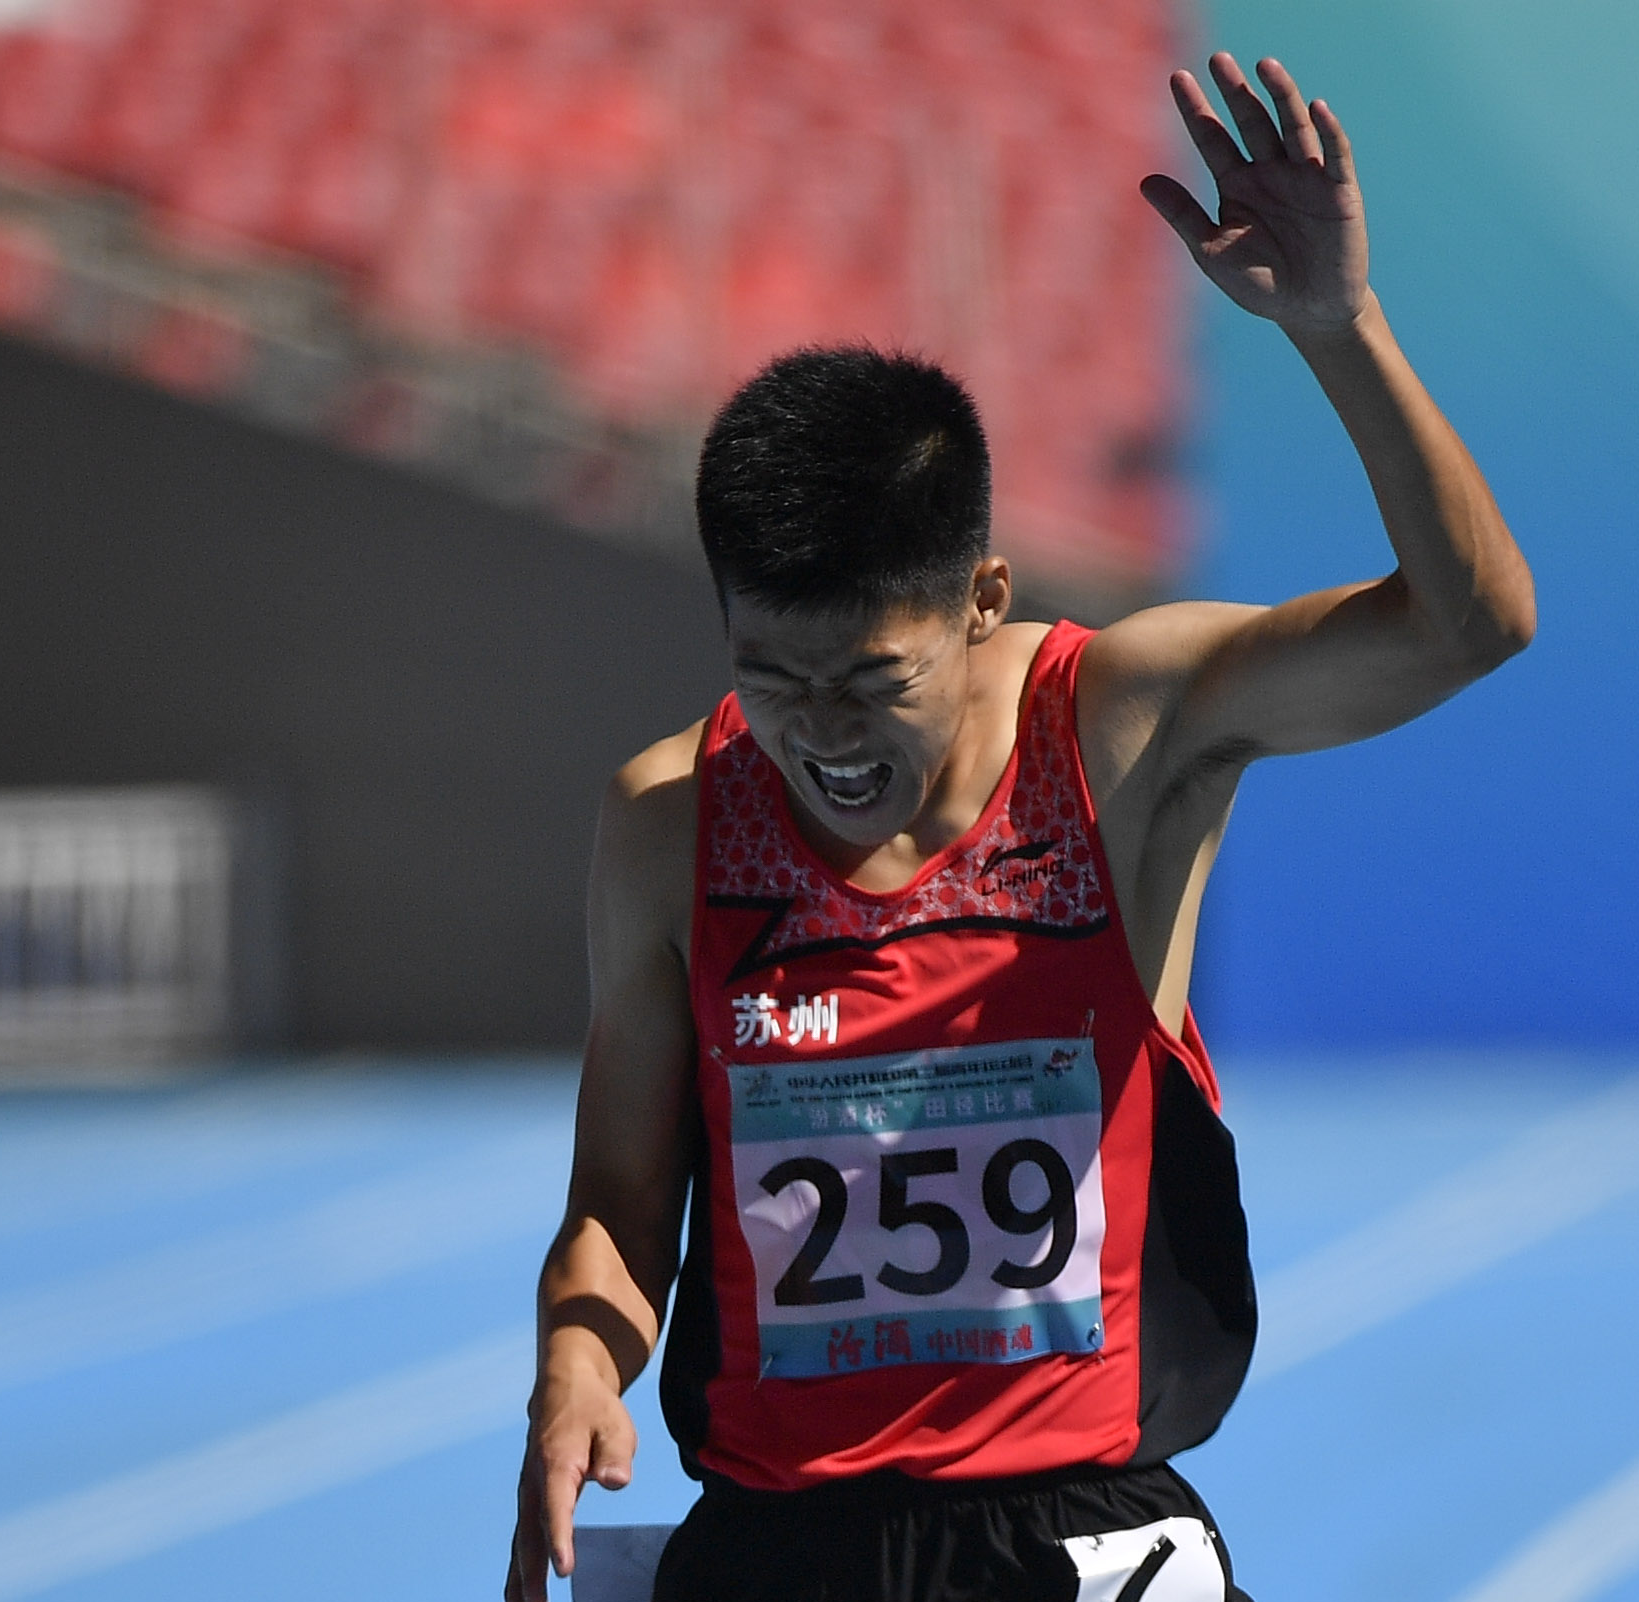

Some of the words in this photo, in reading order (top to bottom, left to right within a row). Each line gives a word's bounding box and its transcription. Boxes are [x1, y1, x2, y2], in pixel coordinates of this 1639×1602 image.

[981, 859, 1065, 897] LI-NING
[731, 992, 839, 1048] 苏州
[758, 1138, 1079, 1308] 259
